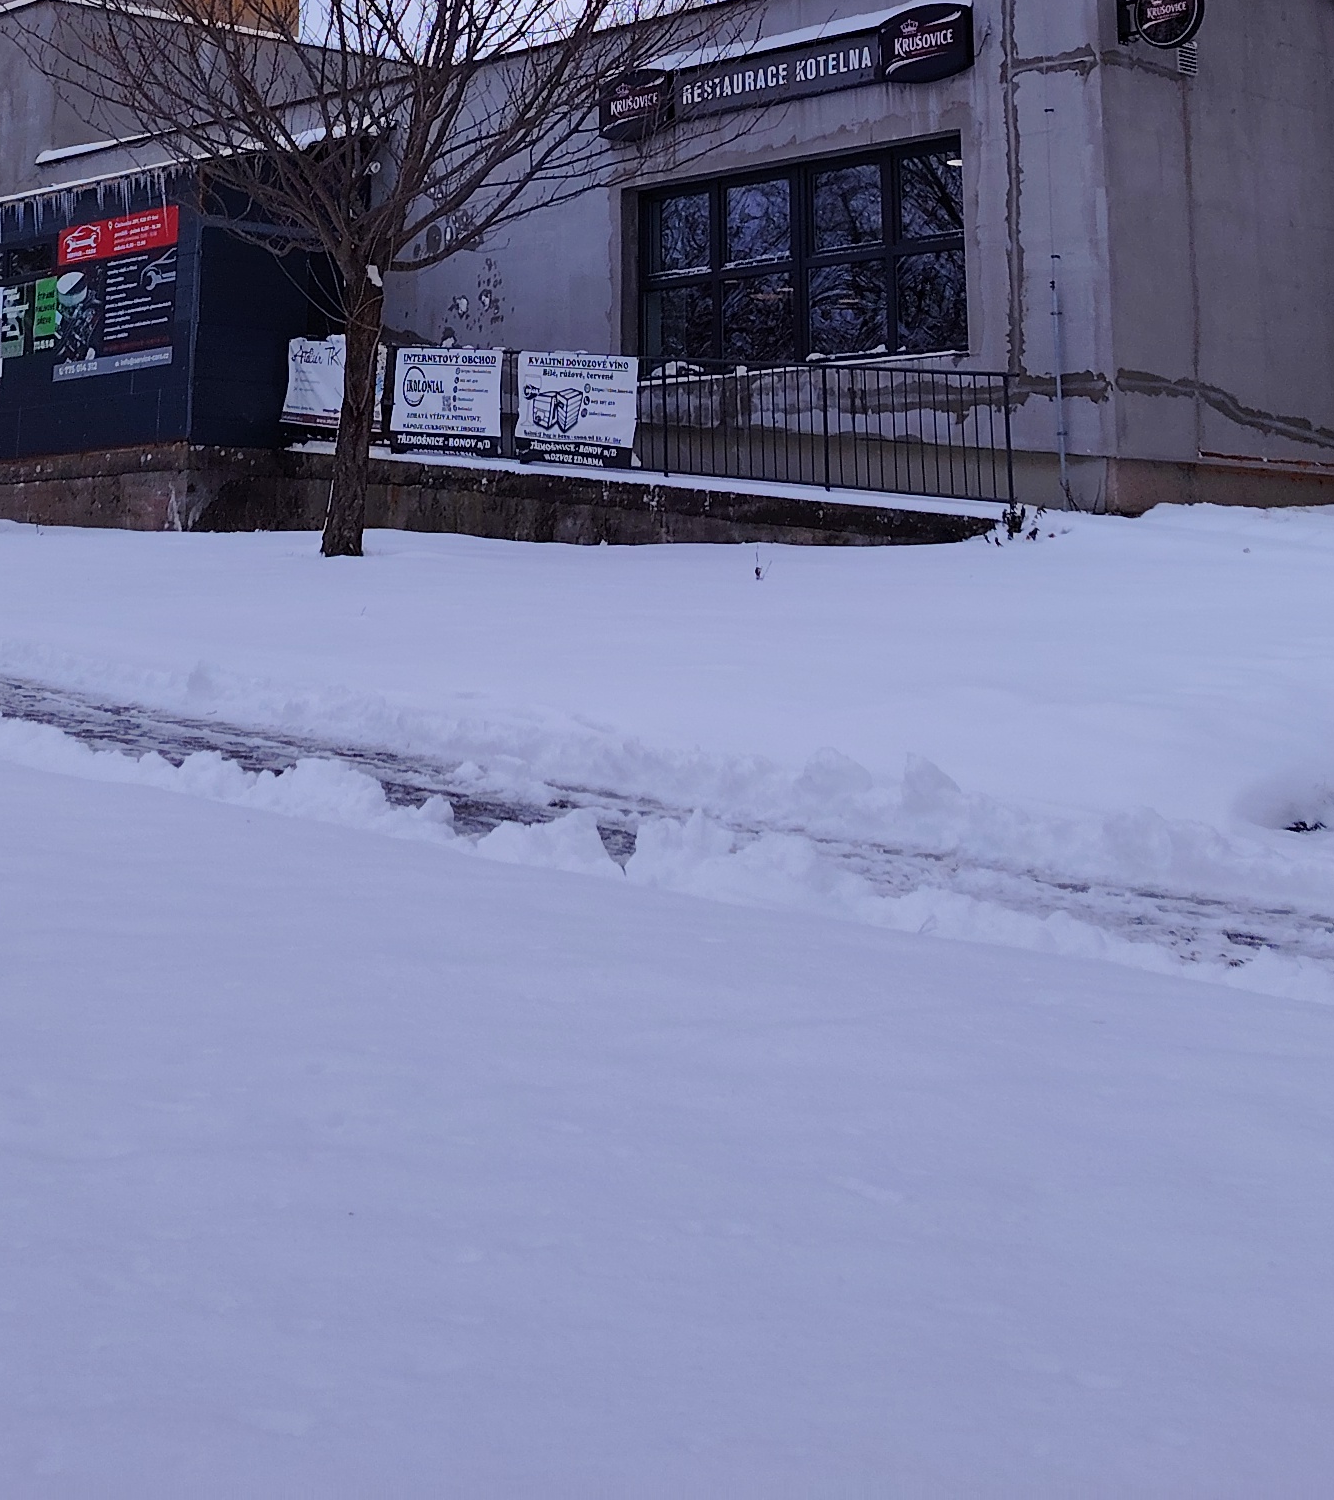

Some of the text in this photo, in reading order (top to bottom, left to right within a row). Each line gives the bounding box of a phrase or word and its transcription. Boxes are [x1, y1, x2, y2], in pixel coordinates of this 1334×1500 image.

[1147, 1, 1187, 19] KRUŠOVICE
[894, 29, 954, 58] KRUŠOVICE
[682, 46, 872, 105] RESTAURACE KOTELNA
[610, 92, 658, 118] KRUŠOVICE
[403, 353, 497, 365] INTERNETOVÝ OBCHOD
[528, 356, 629, 370] KVALITNÍ DOVOZOVÉ VÍNO
[586, 371, 614, 381] červené
[397, 433, 444, 446] TŘEMOŠNICE
[448, 438, 476, 448] RONOV
[573, 456, 604, 467] ZDARMA
